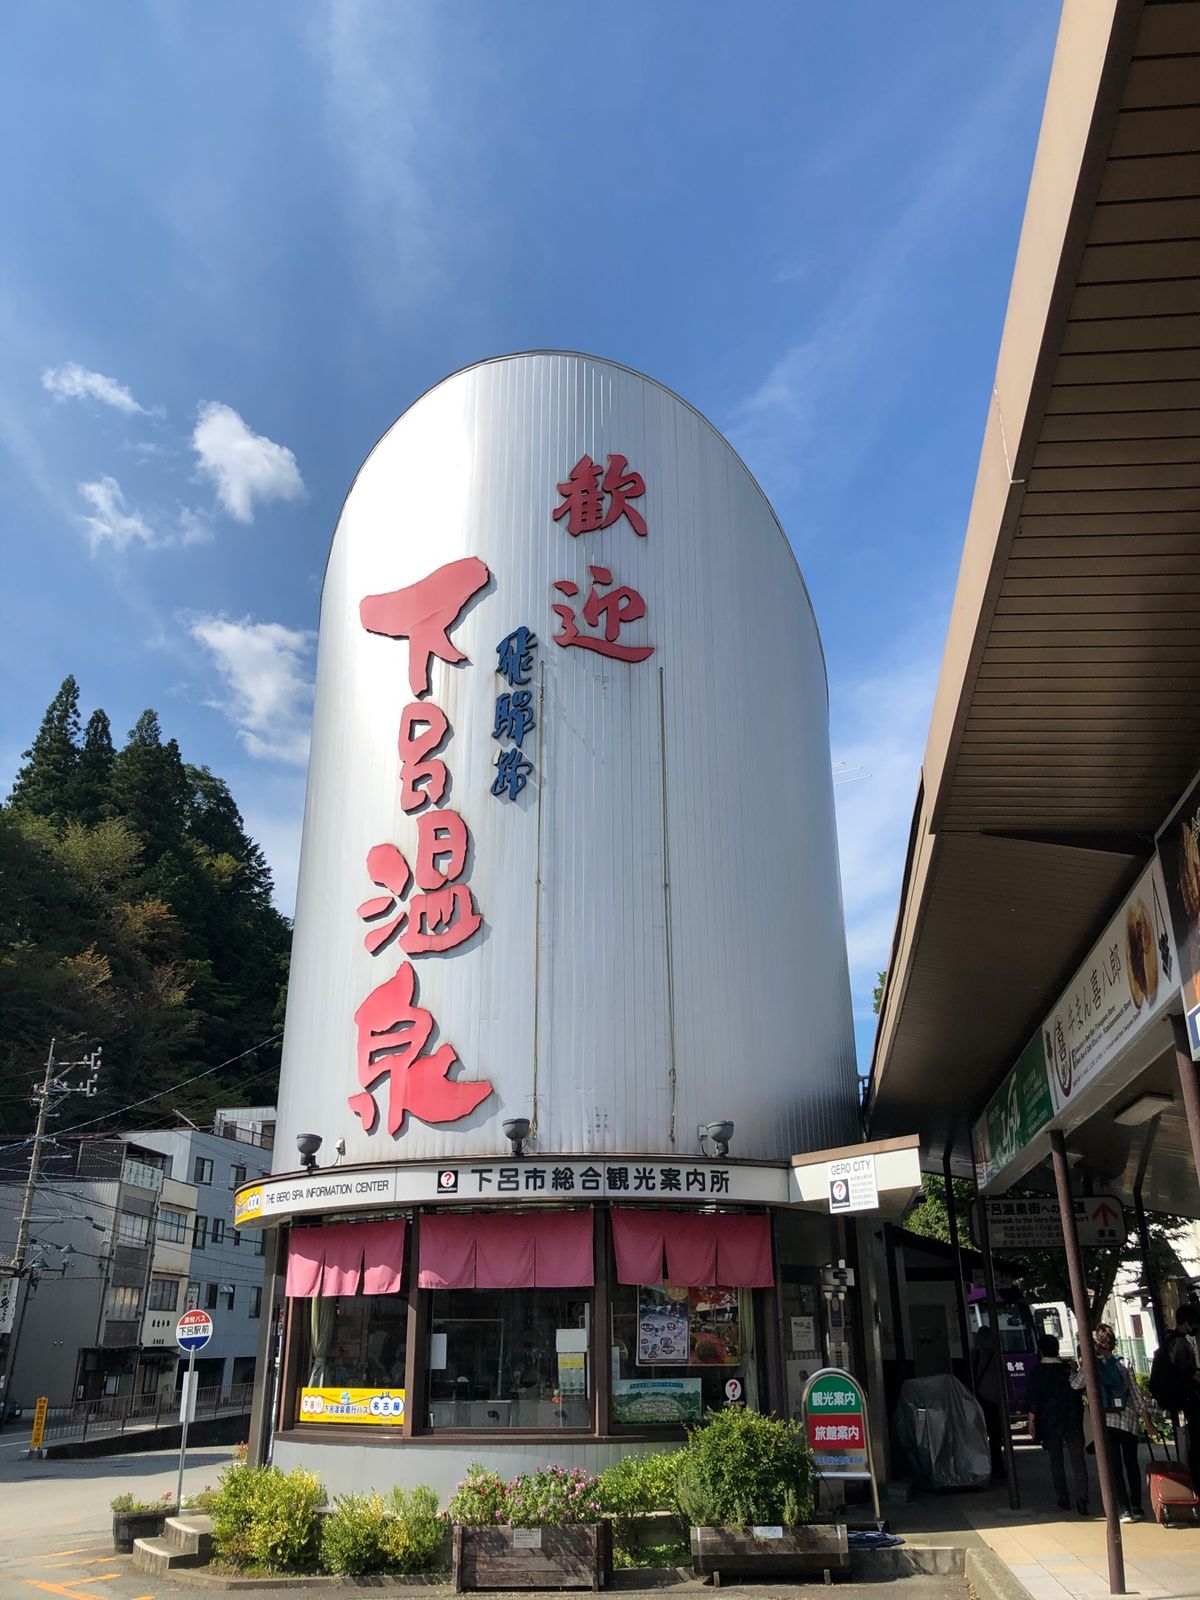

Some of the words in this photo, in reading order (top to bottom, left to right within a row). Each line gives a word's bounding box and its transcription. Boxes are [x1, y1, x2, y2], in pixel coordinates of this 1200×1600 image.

[552, 453, 655, 664] 歓迎
[348, 556, 494, 1137] 下呂温泉
[831, 1162, 851, 1176] GERO
[853, 1160, 871, 1172] CITY
[470, 1166, 730, 1193] 下呂市総合観光案内所
[266, 1194, 275, 1205] THE
[276, 1191, 290, 1203] GERO
[292, 1190, 303, 1200] SPA
[306, 1183, 353, 1199] INFORMATION
[356, 1179, 389, 1192] CENTER
[179, 1325, 209, 1336] 下呂駅前
[373, 1401, 400, 1411] 名古屋
[811, 1391, 856, 1407] 観光案内
[814, 1425, 860, 1441] 旅館案内
